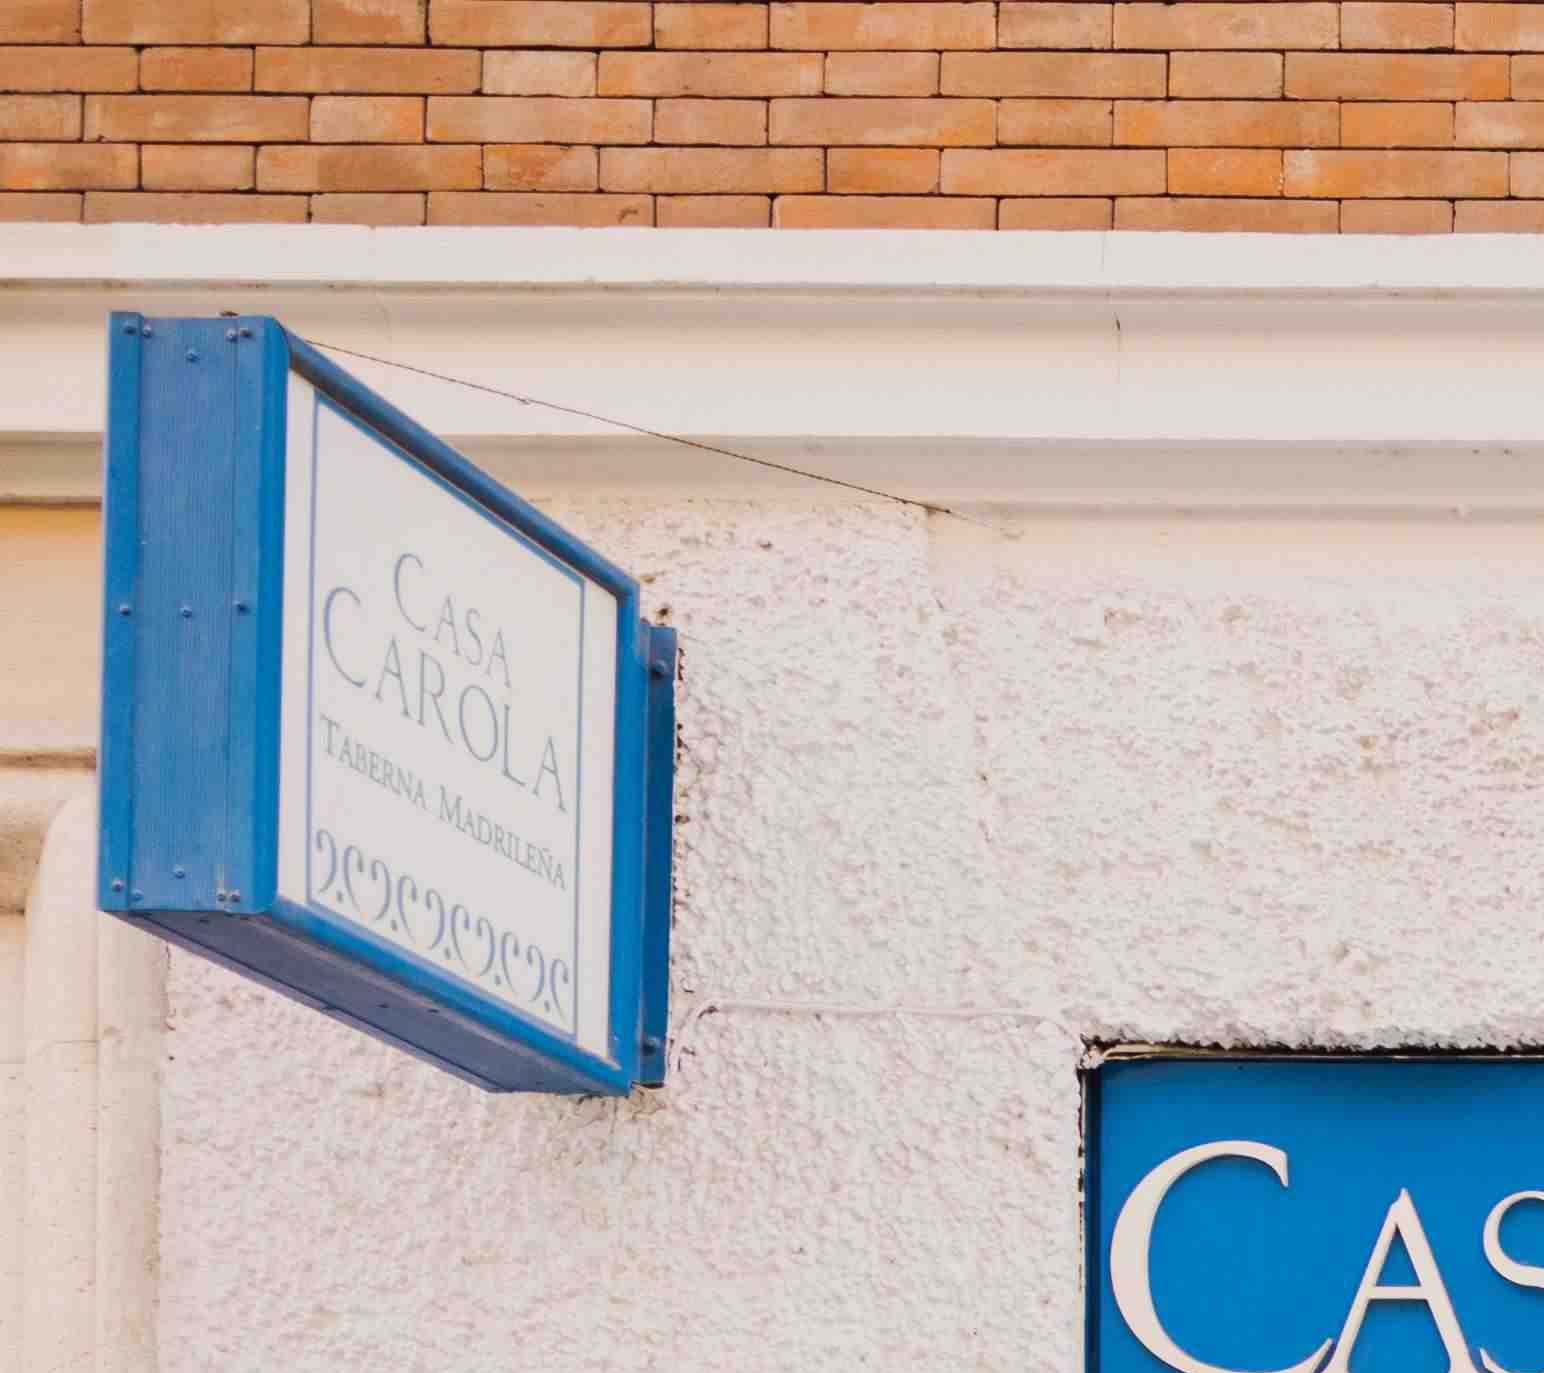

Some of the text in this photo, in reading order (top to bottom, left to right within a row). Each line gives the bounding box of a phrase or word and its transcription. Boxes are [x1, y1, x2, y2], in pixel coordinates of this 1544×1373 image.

[323, 586, 569, 814] CAROLA
[393, 552, 513, 687] CASA
[321, 713, 568, 891] TABERNA MADRILEÑA
